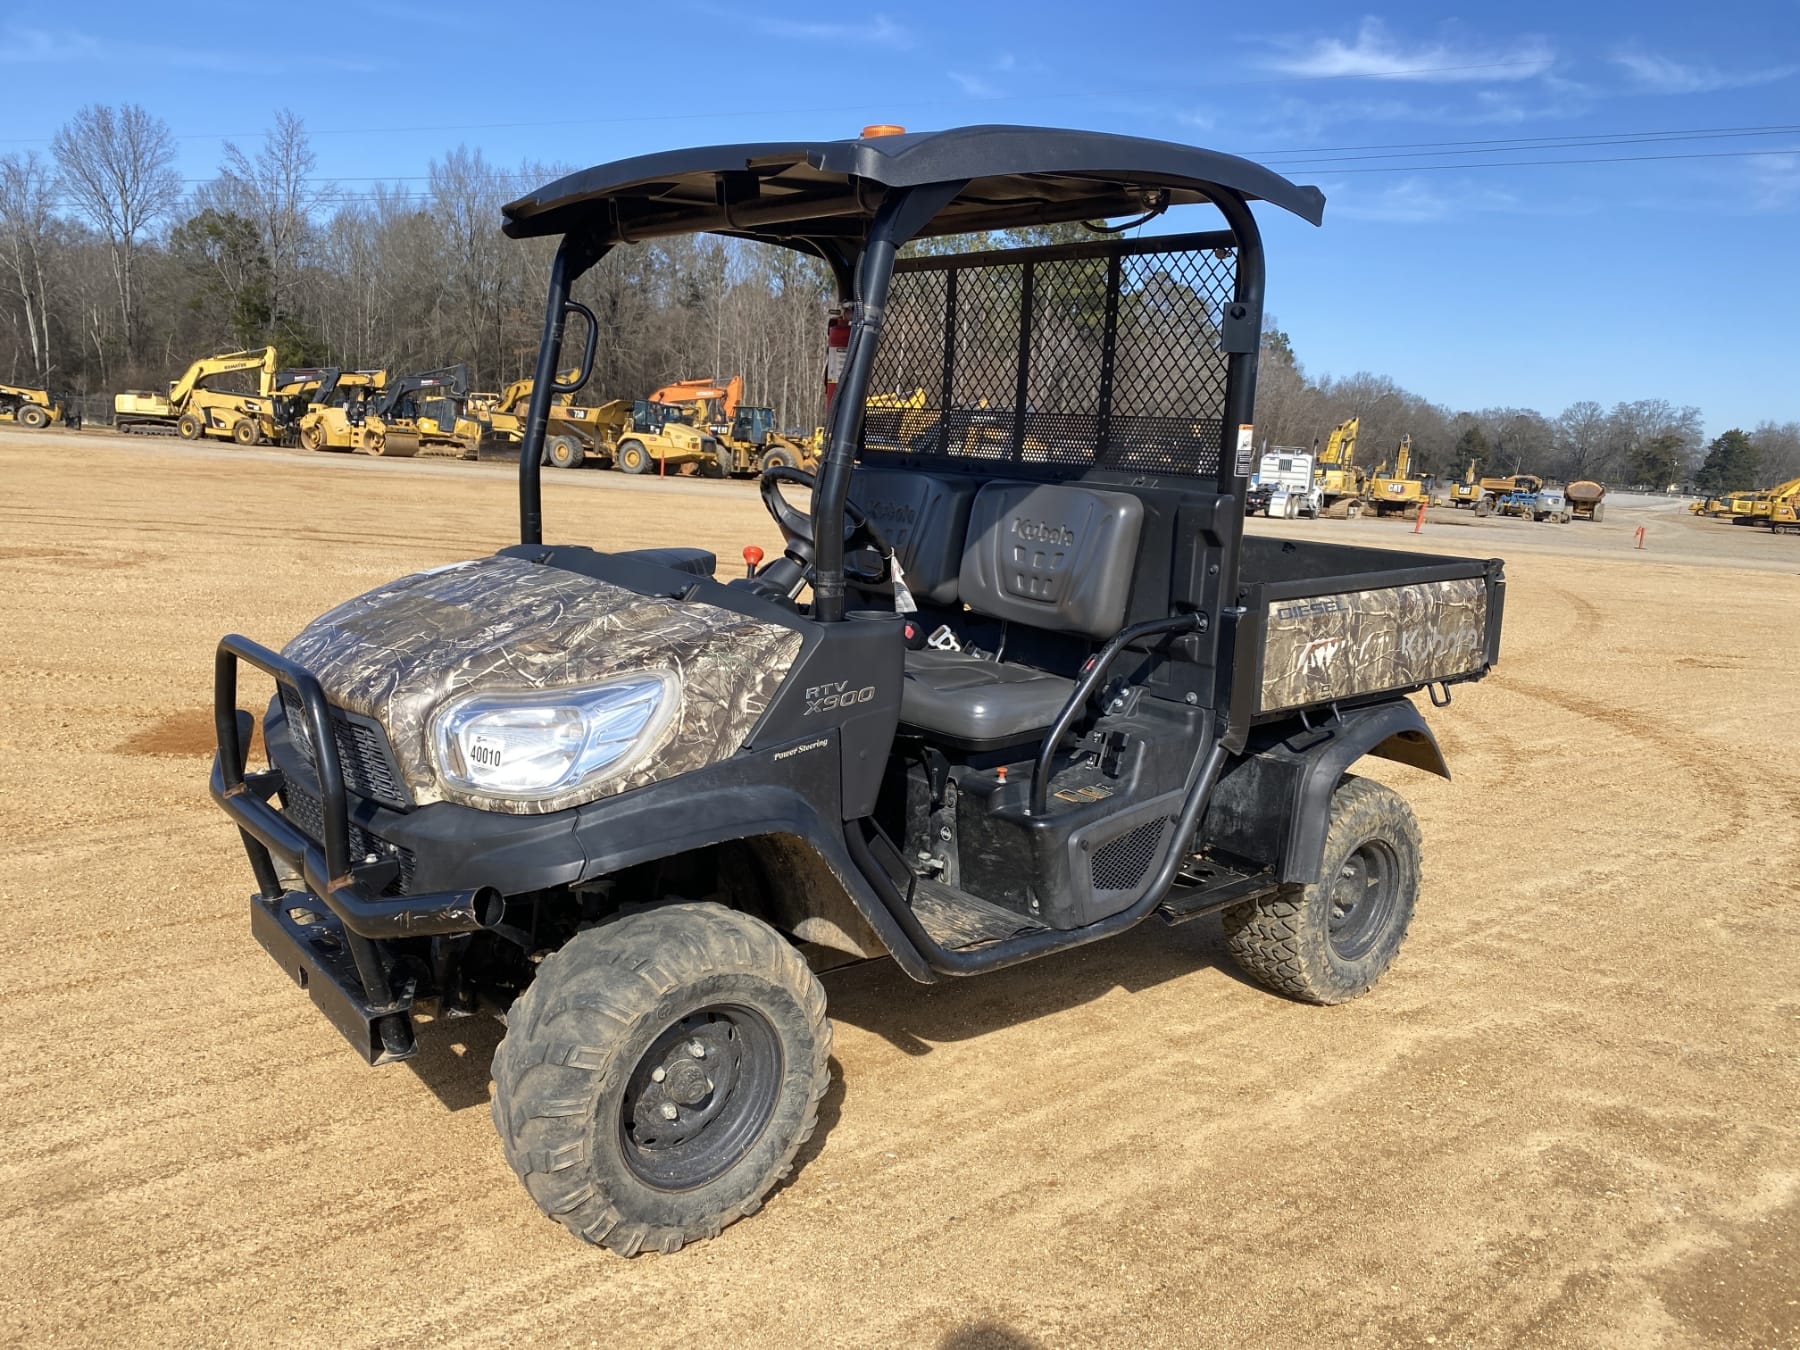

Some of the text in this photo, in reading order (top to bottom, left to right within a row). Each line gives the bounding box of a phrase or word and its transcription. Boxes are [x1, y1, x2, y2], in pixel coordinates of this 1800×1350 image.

[1388, 484, 1402, 493] CAT
[1459, 486, 1471, 494] CAT
[1278, 601, 1350, 620] DIESEL
[1401, 626, 1479, 661] Kubota
[806, 680, 849, 699] RTV
[803, 686, 876, 716] X900
[470, 744, 501, 767] 40010
[774, 739, 828, 761] Power Steering
